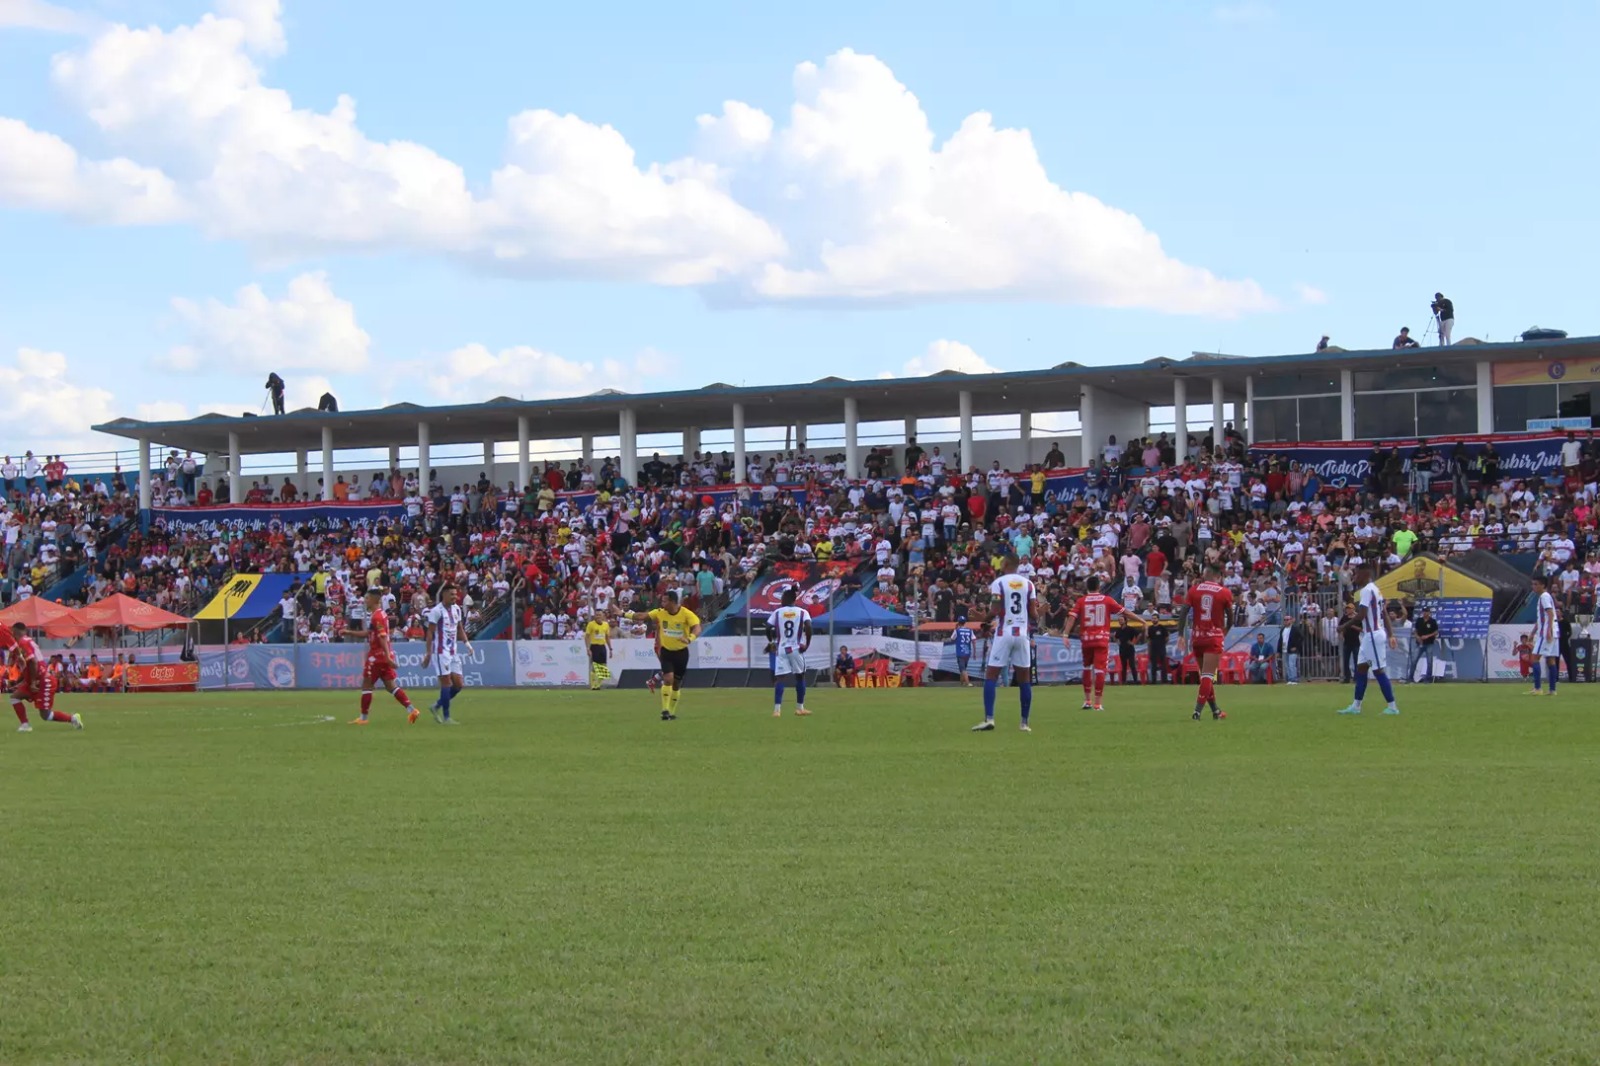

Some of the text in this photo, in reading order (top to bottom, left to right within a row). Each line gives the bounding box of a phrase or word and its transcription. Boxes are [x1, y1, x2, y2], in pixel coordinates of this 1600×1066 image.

[1010, 591, 1022, 615] 3
[1084, 603, 1106, 627] 50
[1200, 594, 1213, 621] 9
[784, 620, 794, 638] 8
